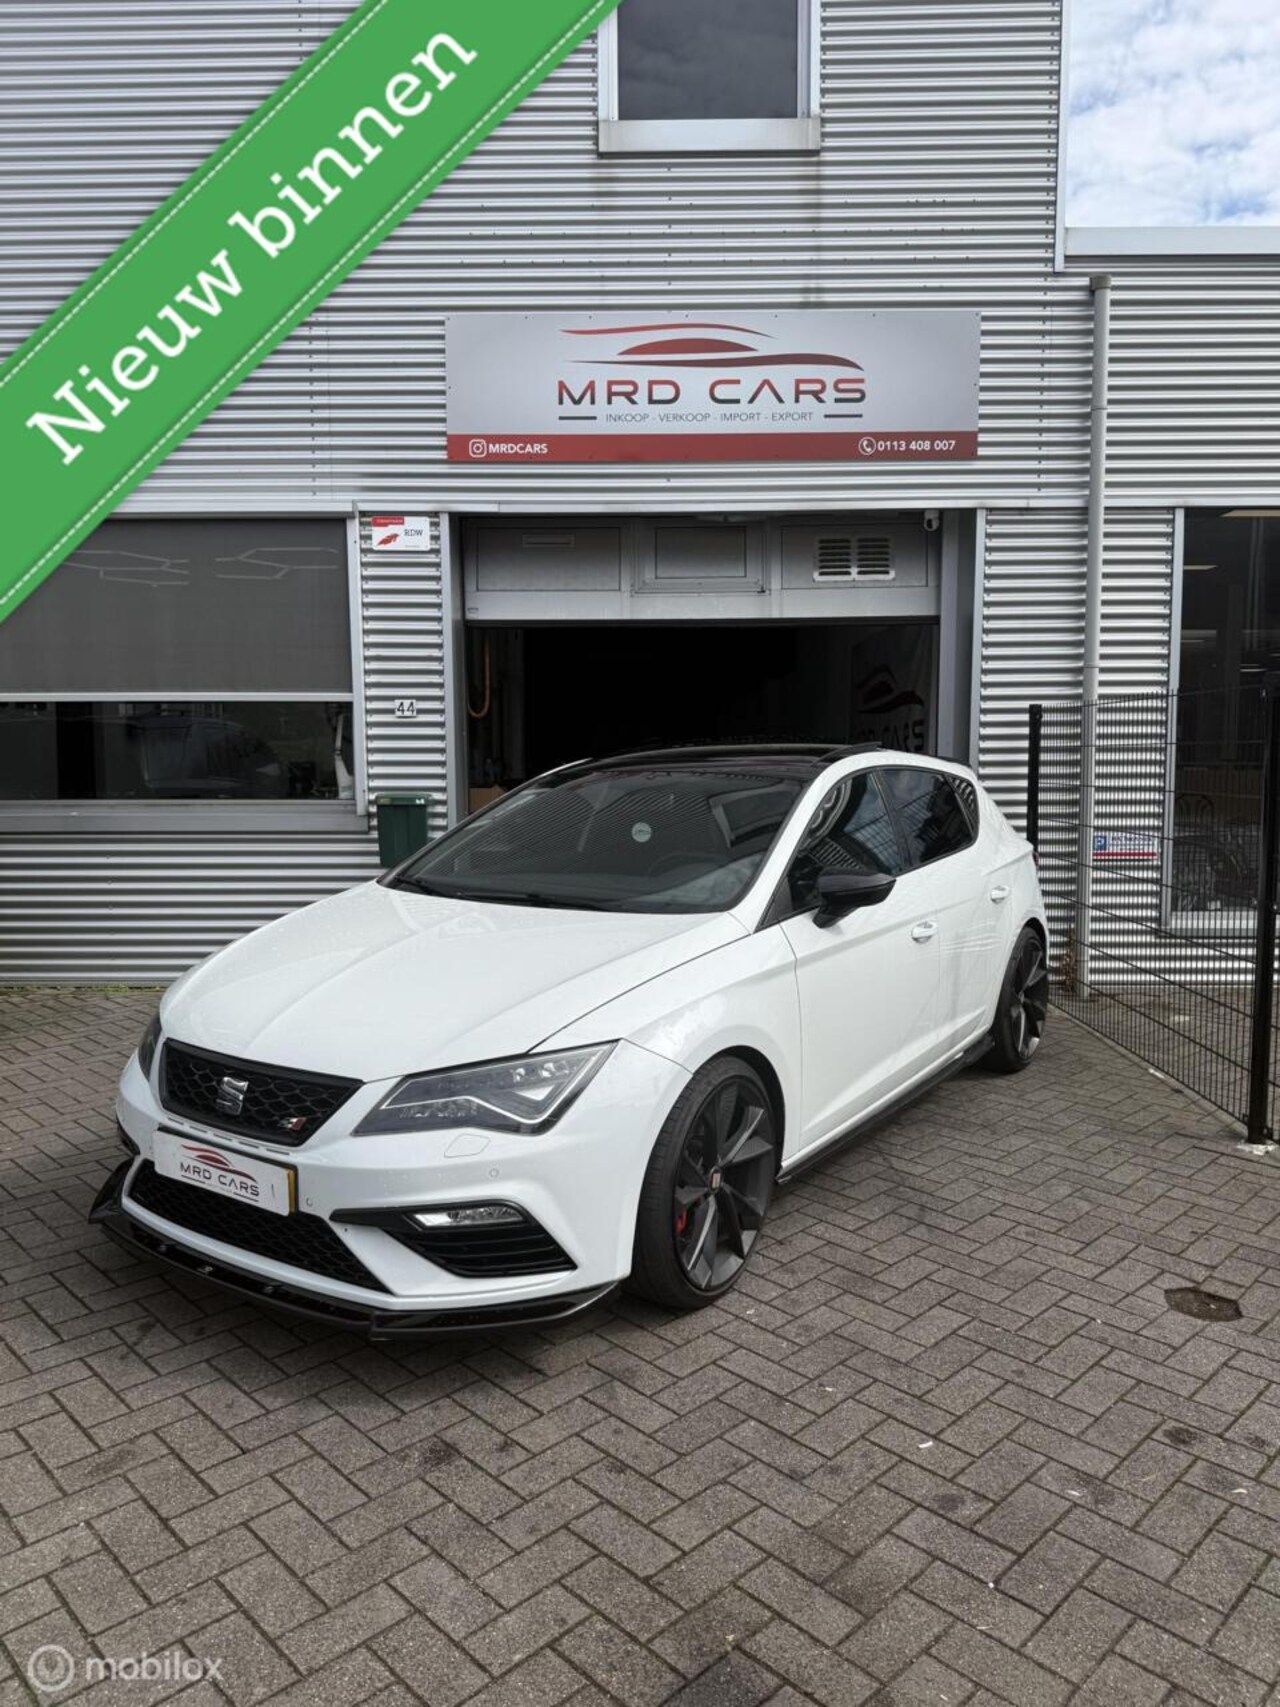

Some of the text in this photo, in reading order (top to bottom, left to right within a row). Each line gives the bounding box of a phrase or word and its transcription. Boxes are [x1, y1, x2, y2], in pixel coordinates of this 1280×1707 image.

[558, 378, 866, 405] MRD CARS
[605, 412, 650, 423] INKOOP
[658, 412, 711, 423] VERKOOP
[720, 412, 761, 422] IMPORT
[771, 411, 813, 422] EXPORT
[488, 443, 549, 454] MRDCARS
[877, 439, 956, 452] 0113 408 007
[404, 528, 424, 537] RDW
[396, 701, 416, 716] 44
[180, 1162, 212, 1180] MRD
[217, 1174, 260, 1197] CARS
